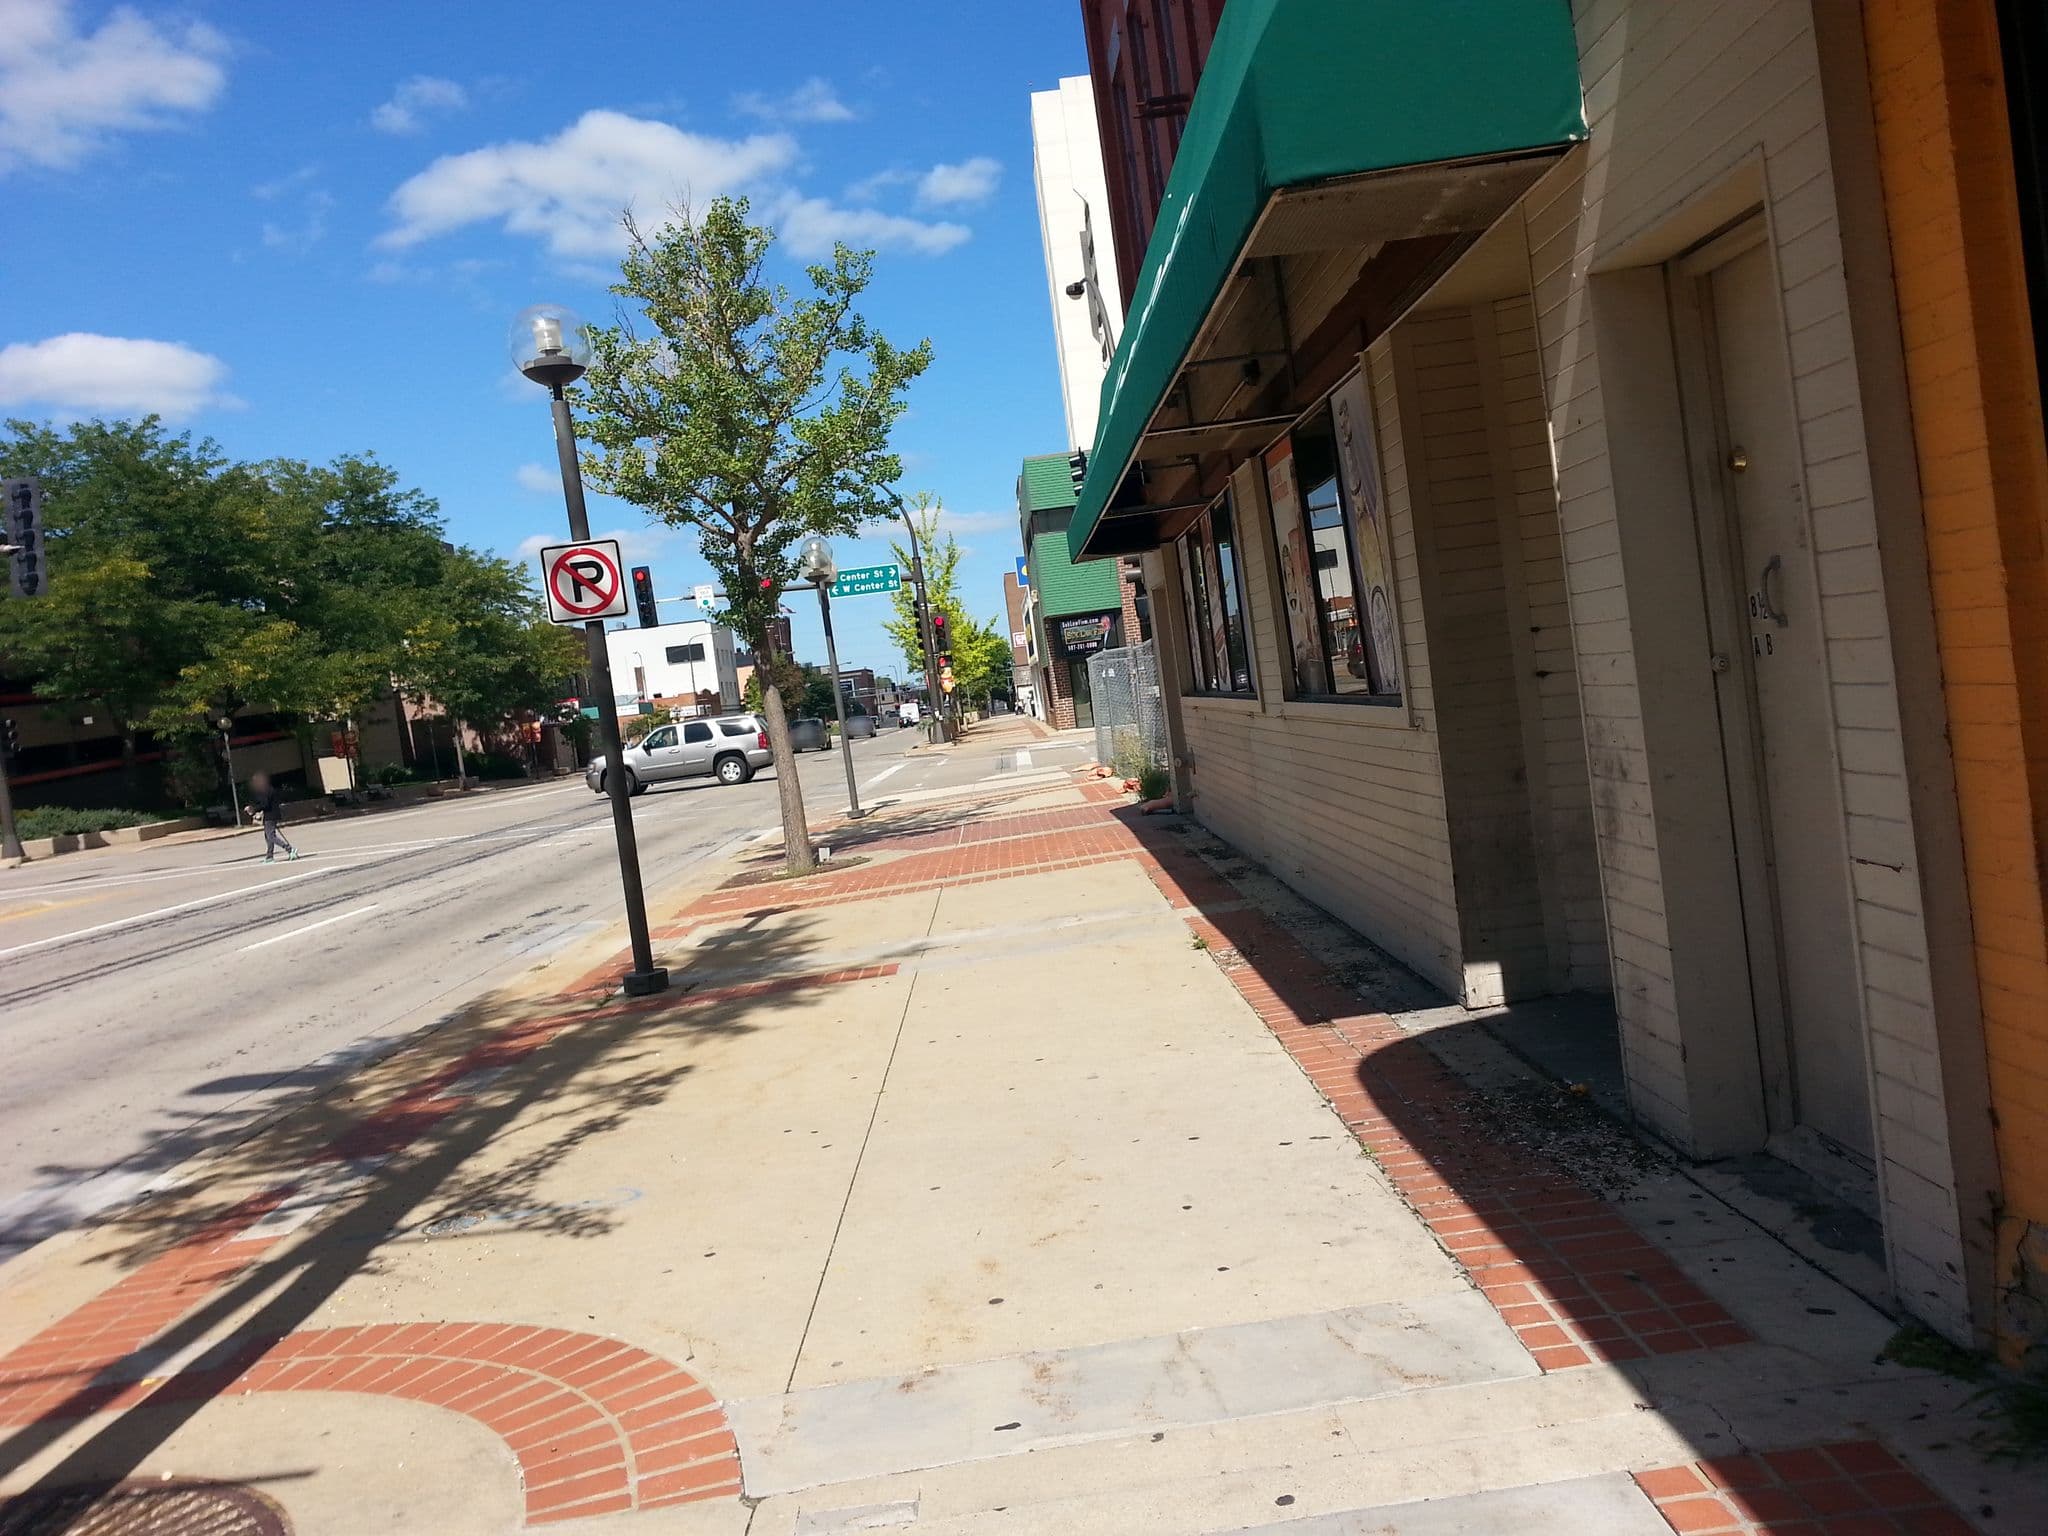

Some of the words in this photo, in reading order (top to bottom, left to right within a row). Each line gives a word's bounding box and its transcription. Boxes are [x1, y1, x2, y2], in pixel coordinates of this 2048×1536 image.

[569, 560, 604, 602] P
[840, 572, 870, 582] Center
[874, 570, 884, 578] St
[842, 584, 850, 592] W
[854, 582, 884, 592] Center
[888, 580, 898, 588] St
